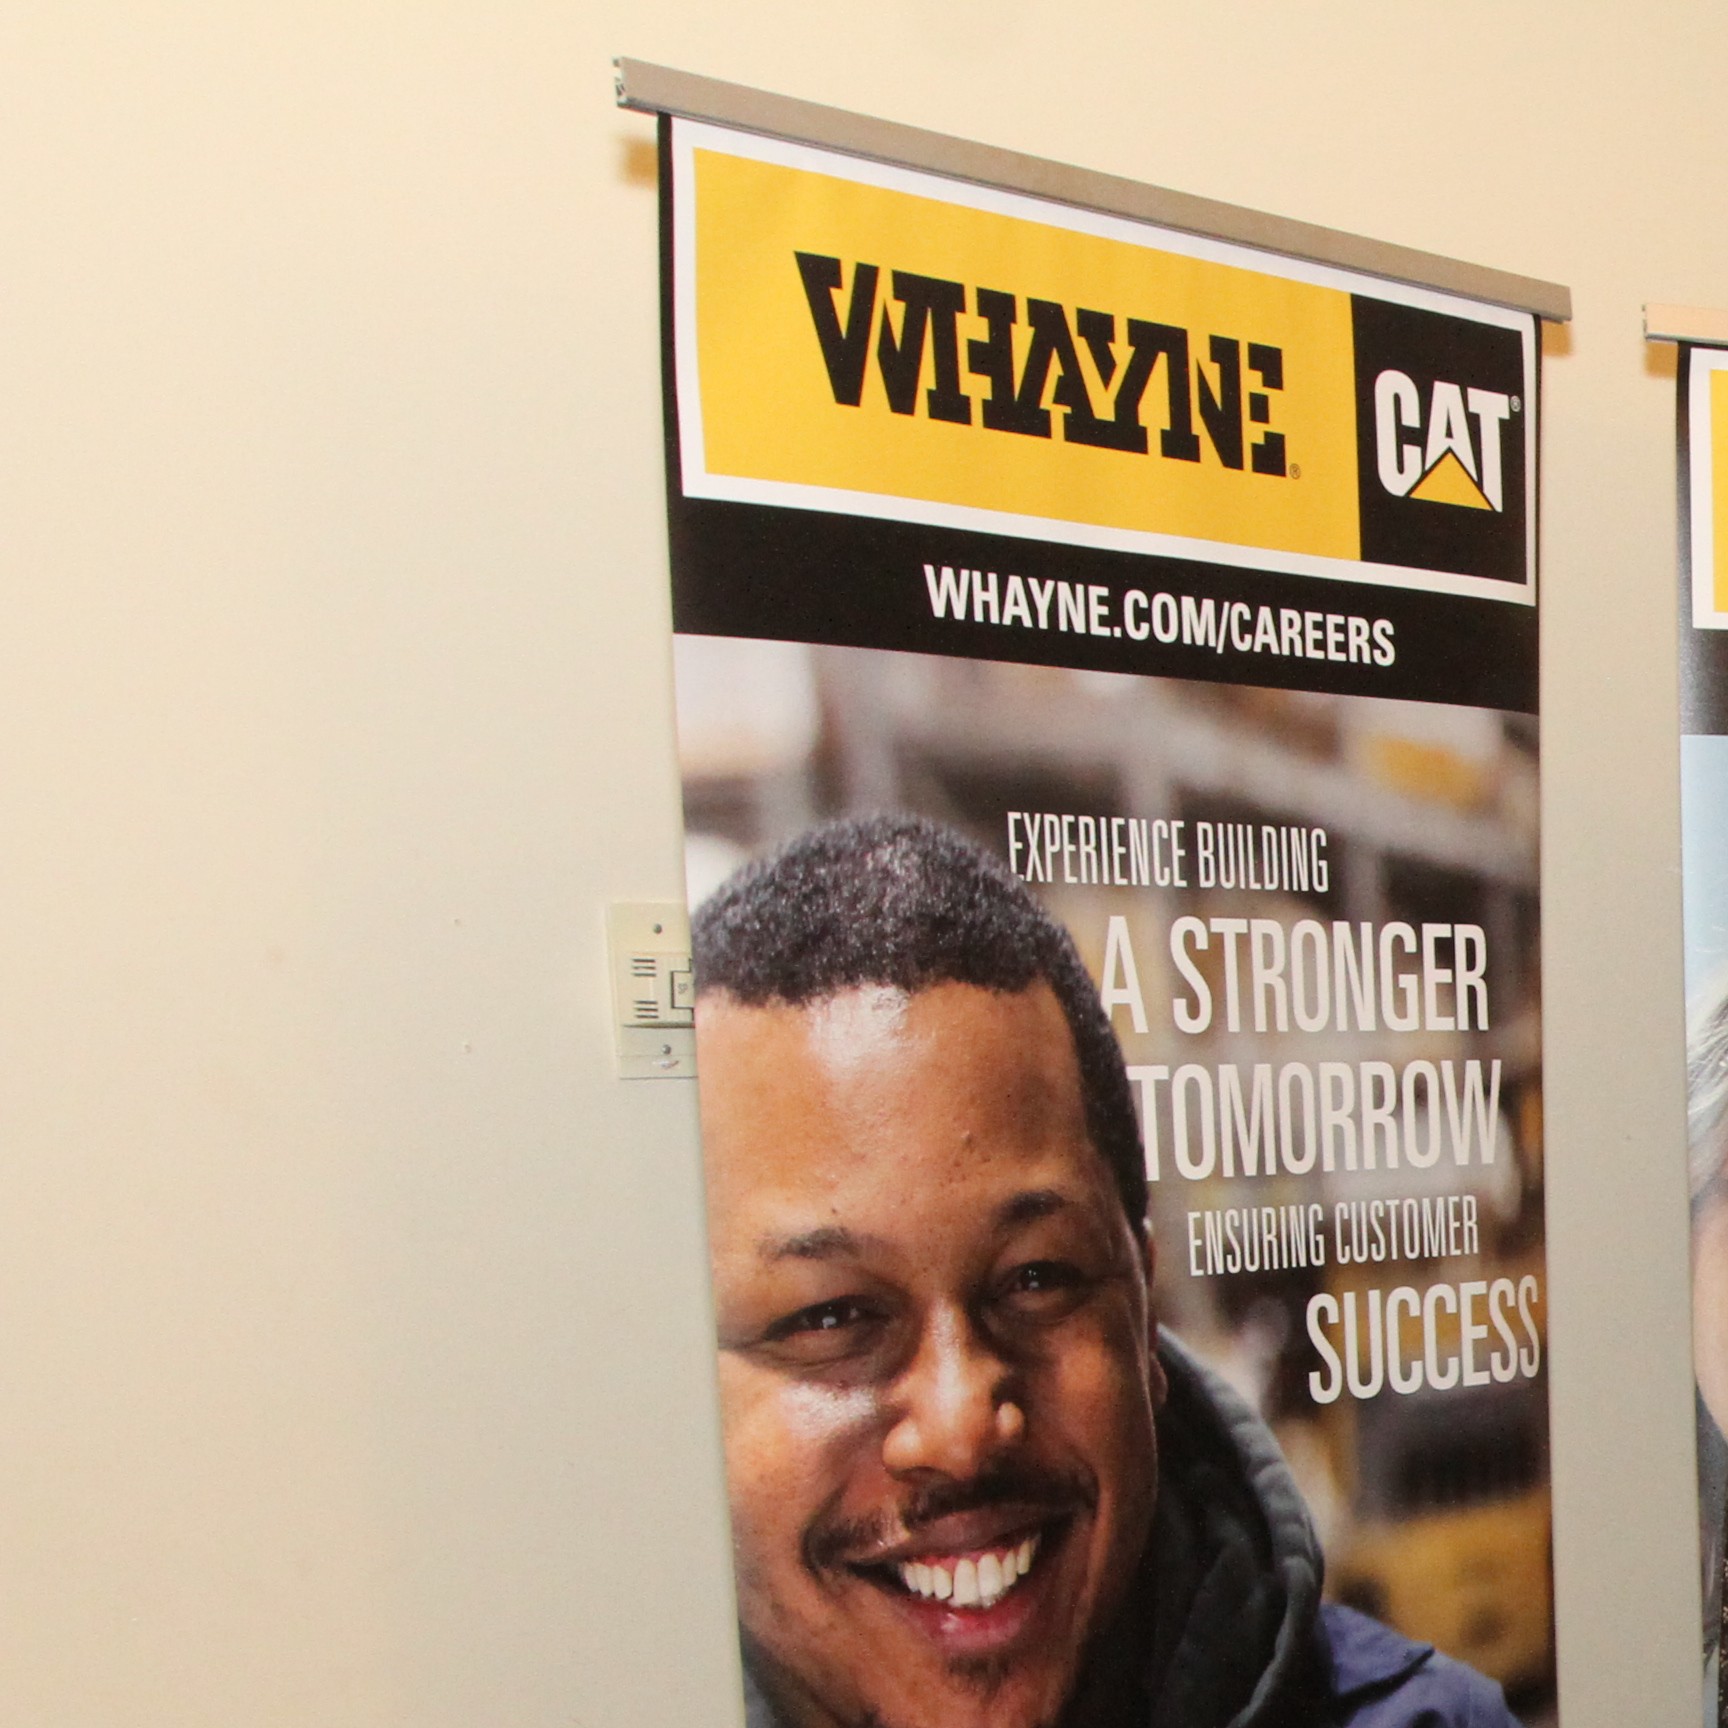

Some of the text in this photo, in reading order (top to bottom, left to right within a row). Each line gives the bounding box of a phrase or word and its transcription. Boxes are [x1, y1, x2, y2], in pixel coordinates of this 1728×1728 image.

[793, 250, 1288, 479] WHAYNE
[1375, 369, 1511, 513] CAT
[924, 564, 1396, 667] WHAYNE.COM/CAREERS
[1007, 811, 1329, 893] EXPERIENCE BUILDING
[1101, 916, 1489, 1035] A STRONGER
[1127, 1059, 1501, 1182] TOMORROW
[1189, 1195, 1479, 1278] ENSURING CUSTOMER
[1306, 1275, 1541, 1405] SUCCESS
